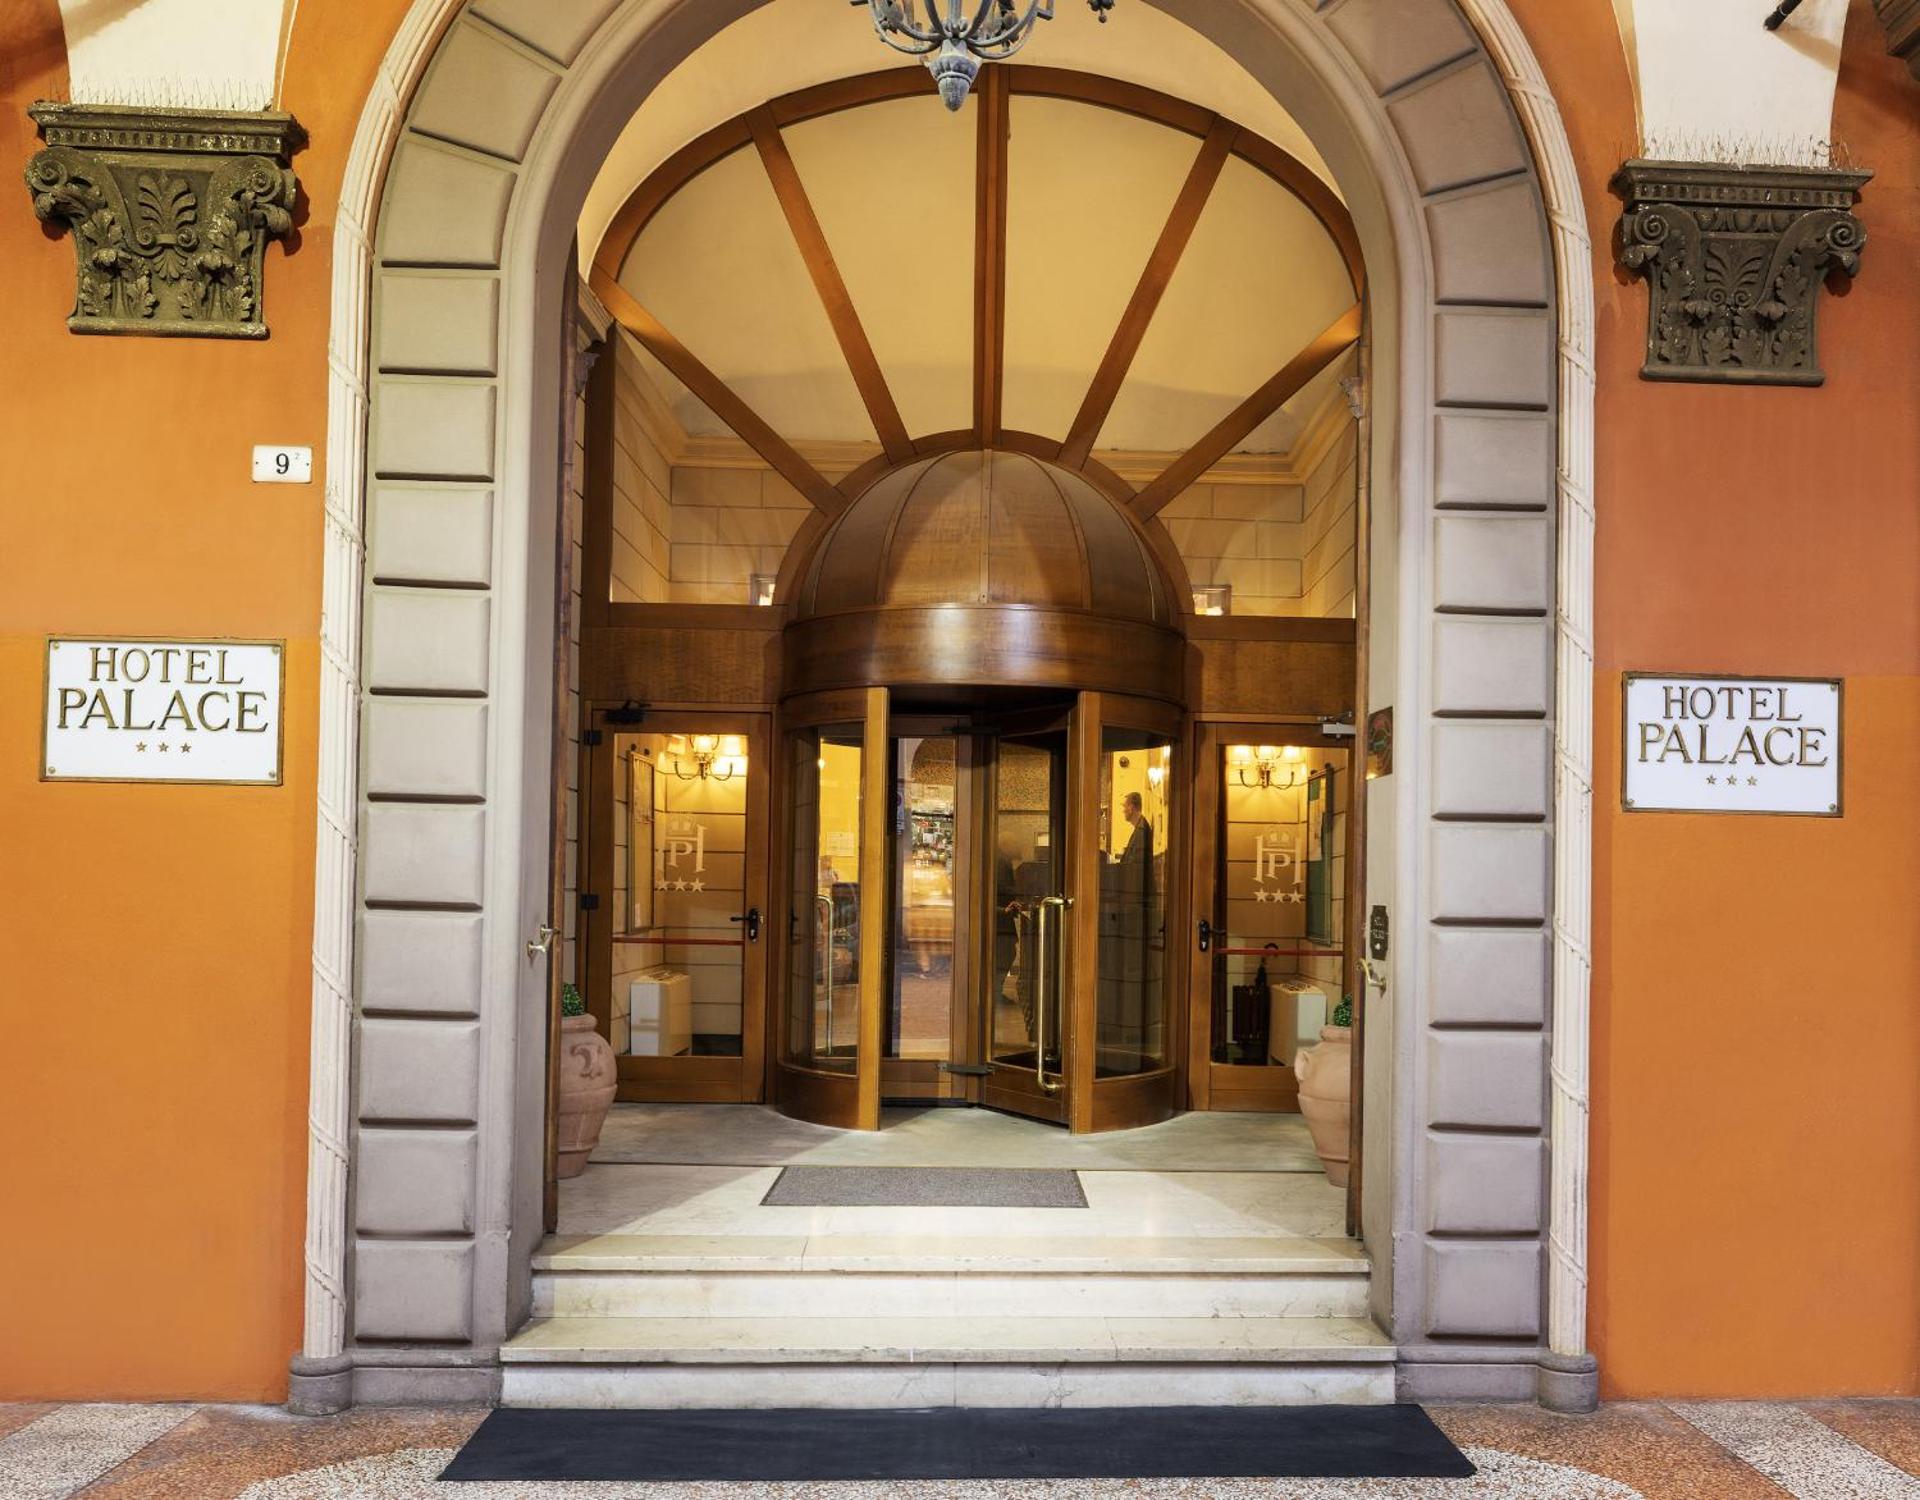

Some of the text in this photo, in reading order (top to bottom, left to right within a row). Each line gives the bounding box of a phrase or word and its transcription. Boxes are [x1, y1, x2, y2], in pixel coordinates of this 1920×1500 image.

[275, 452, 290, 475] 9
[88, 647, 244, 684] HOTEL
[56, 687, 269, 733] PALACE
[1662, 685, 1803, 722] HOTEL
[1637, 722, 1829, 767] PALACE
